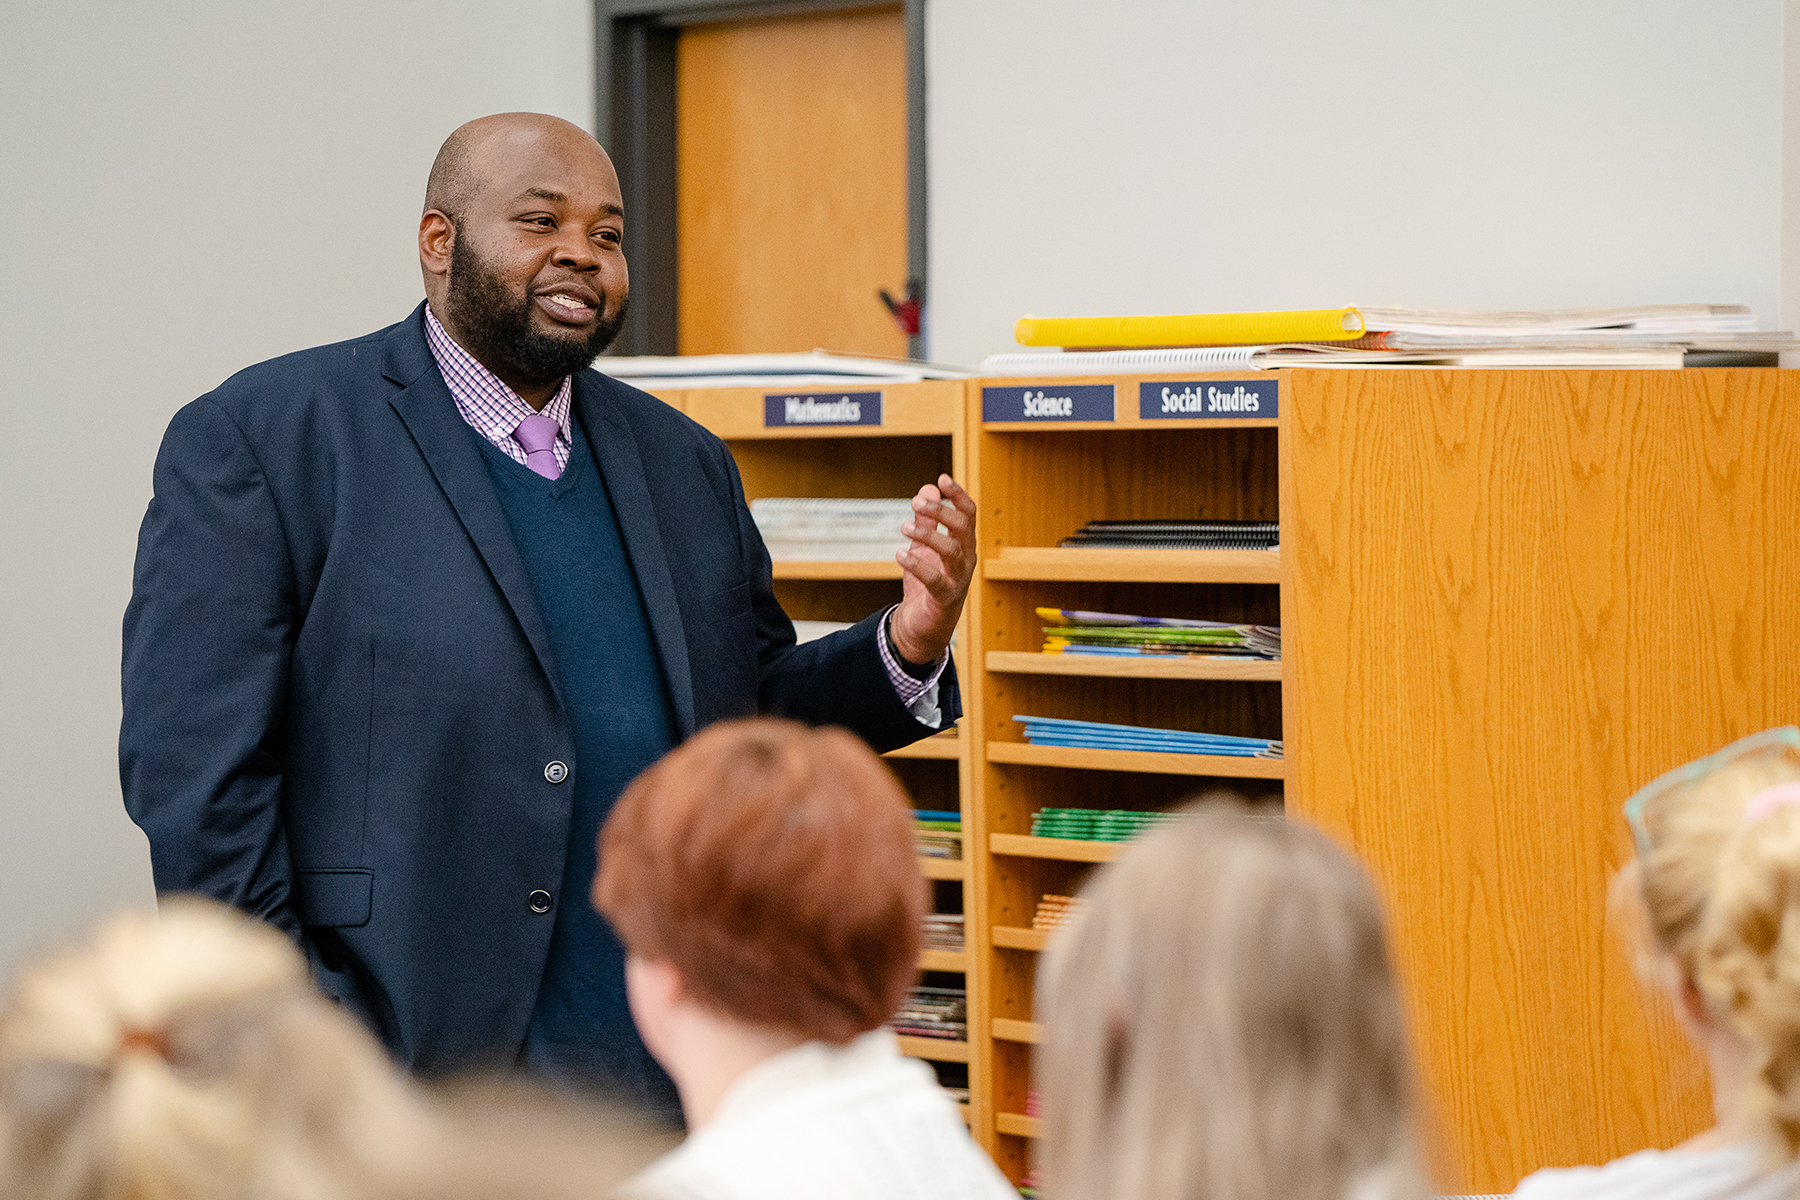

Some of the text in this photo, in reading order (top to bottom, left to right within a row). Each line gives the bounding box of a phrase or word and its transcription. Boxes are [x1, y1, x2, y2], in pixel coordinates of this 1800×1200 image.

[785, 397, 861, 423] Mathematics
[1023, 391, 1072, 416] Science
[1161, 386, 1259, 412] Social Studies
